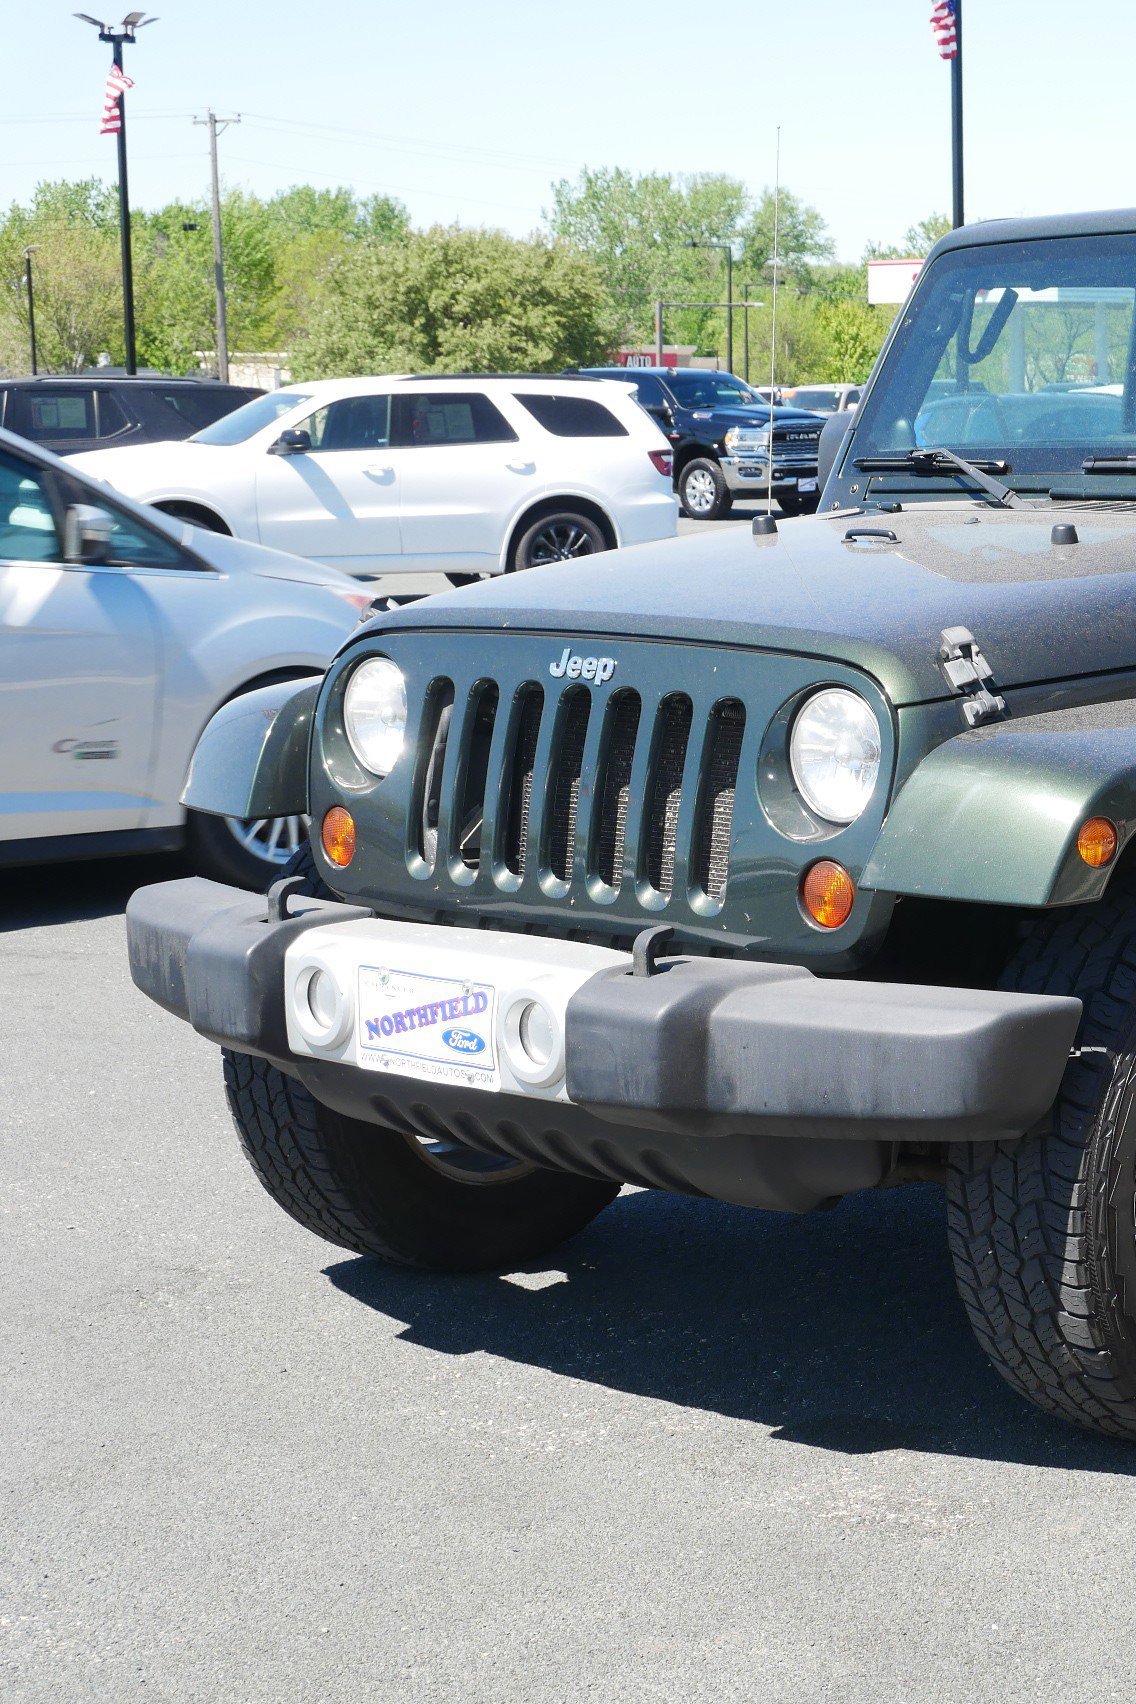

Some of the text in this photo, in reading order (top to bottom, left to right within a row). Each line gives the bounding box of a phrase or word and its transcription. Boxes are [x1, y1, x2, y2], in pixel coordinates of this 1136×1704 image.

[626, 355, 652, 368] AUTO
[549, 647, 617, 687] Jeep
[364, 990, 489, 1041] NORTHFIELD
[449, 1029, 478, 1051] Ford
[360, 1051, 494, 1085] WWWNORTHFIELDAUTOSCOM
